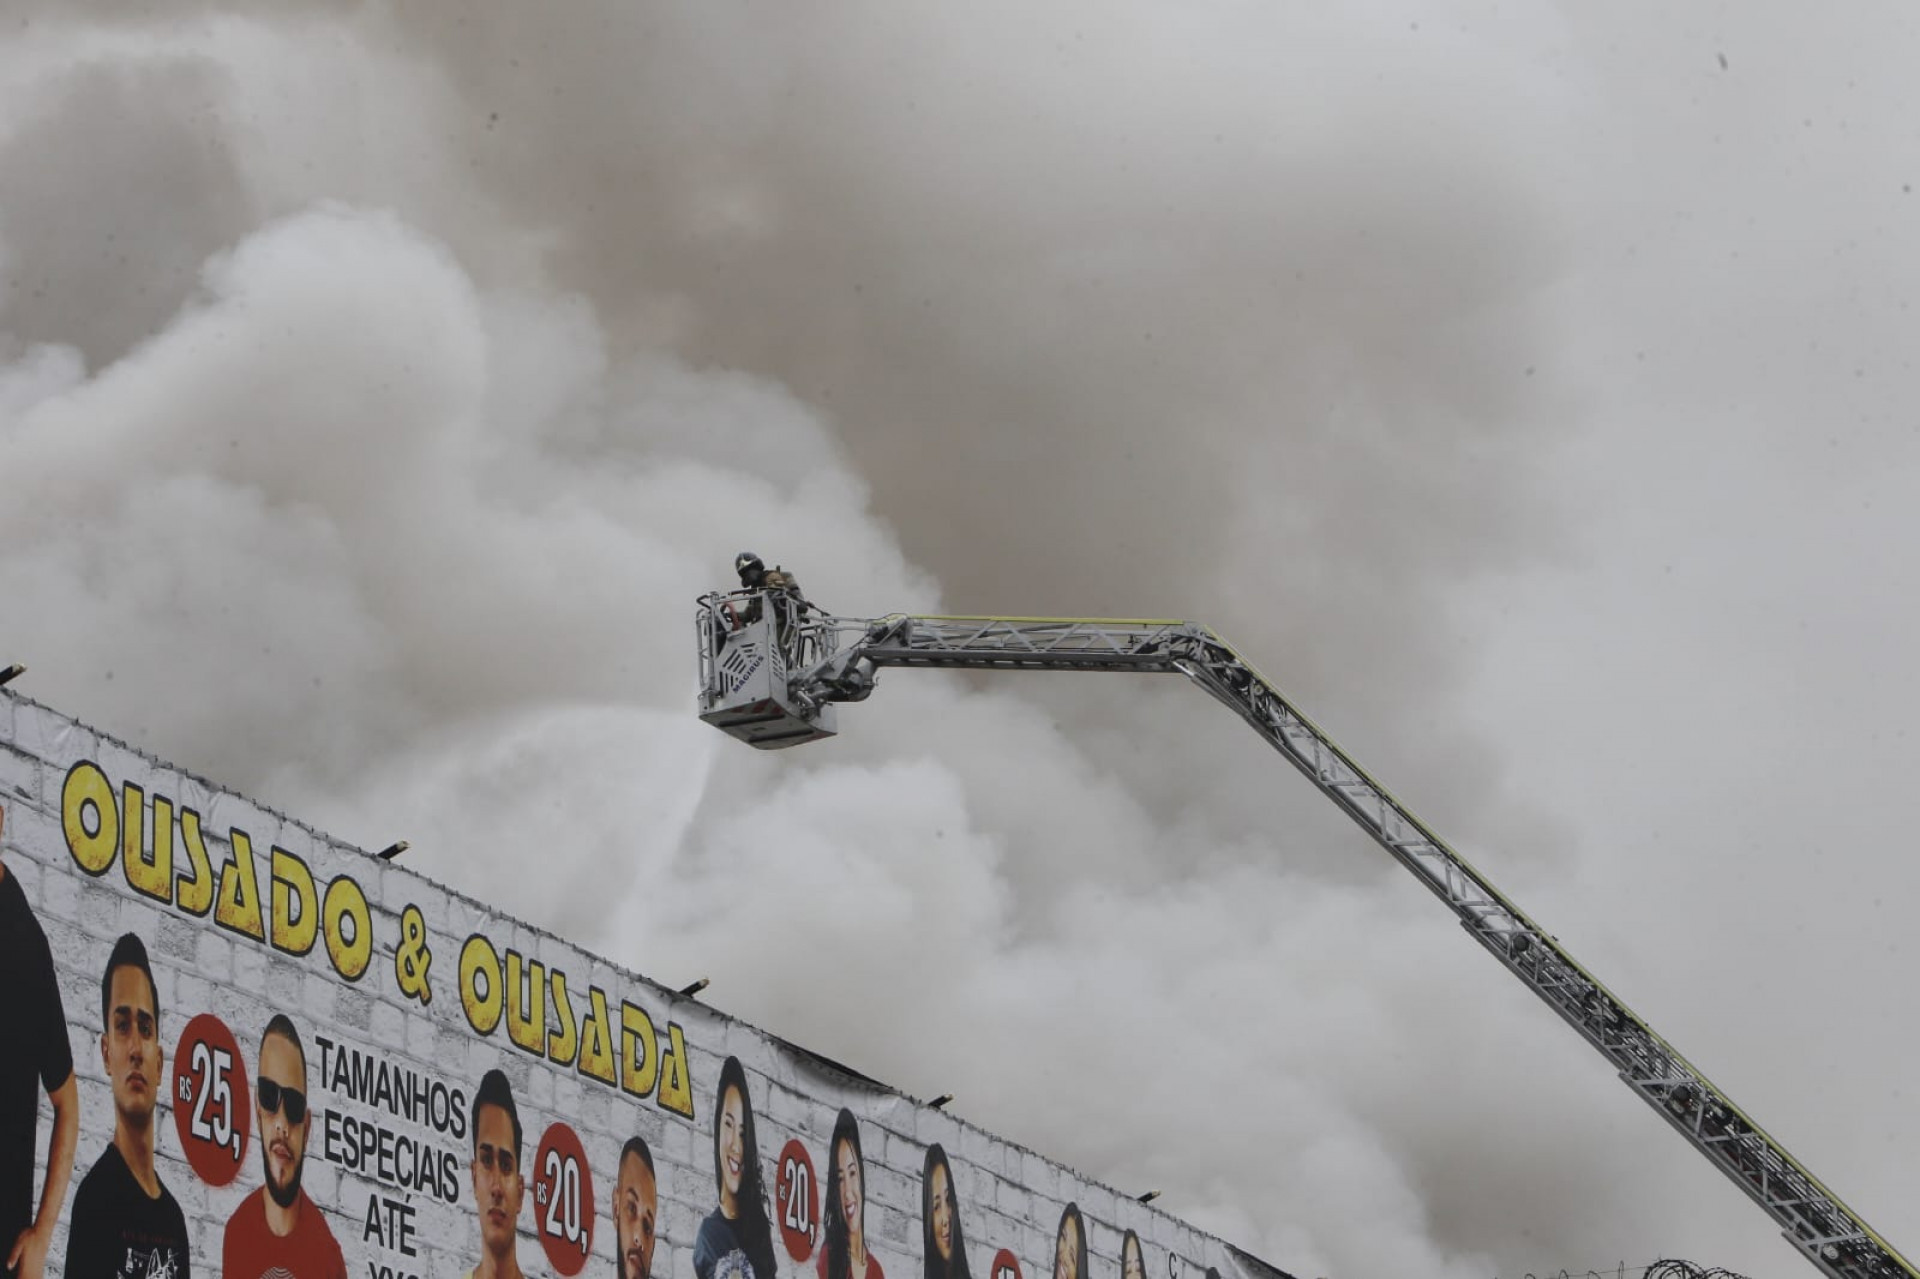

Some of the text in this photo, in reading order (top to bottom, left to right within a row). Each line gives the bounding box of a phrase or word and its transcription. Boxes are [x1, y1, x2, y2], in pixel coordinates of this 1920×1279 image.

[732, 655, 764, 693] MAGIRUS
[61, 759, 695, 1120] OUSADO & OUSADA
[315, 1036, 466, 1139] TAMANHOS
[324, 1109, 459, 1204] ESPECIAIS
[363, 1194, 417, 1257] ATÉ
